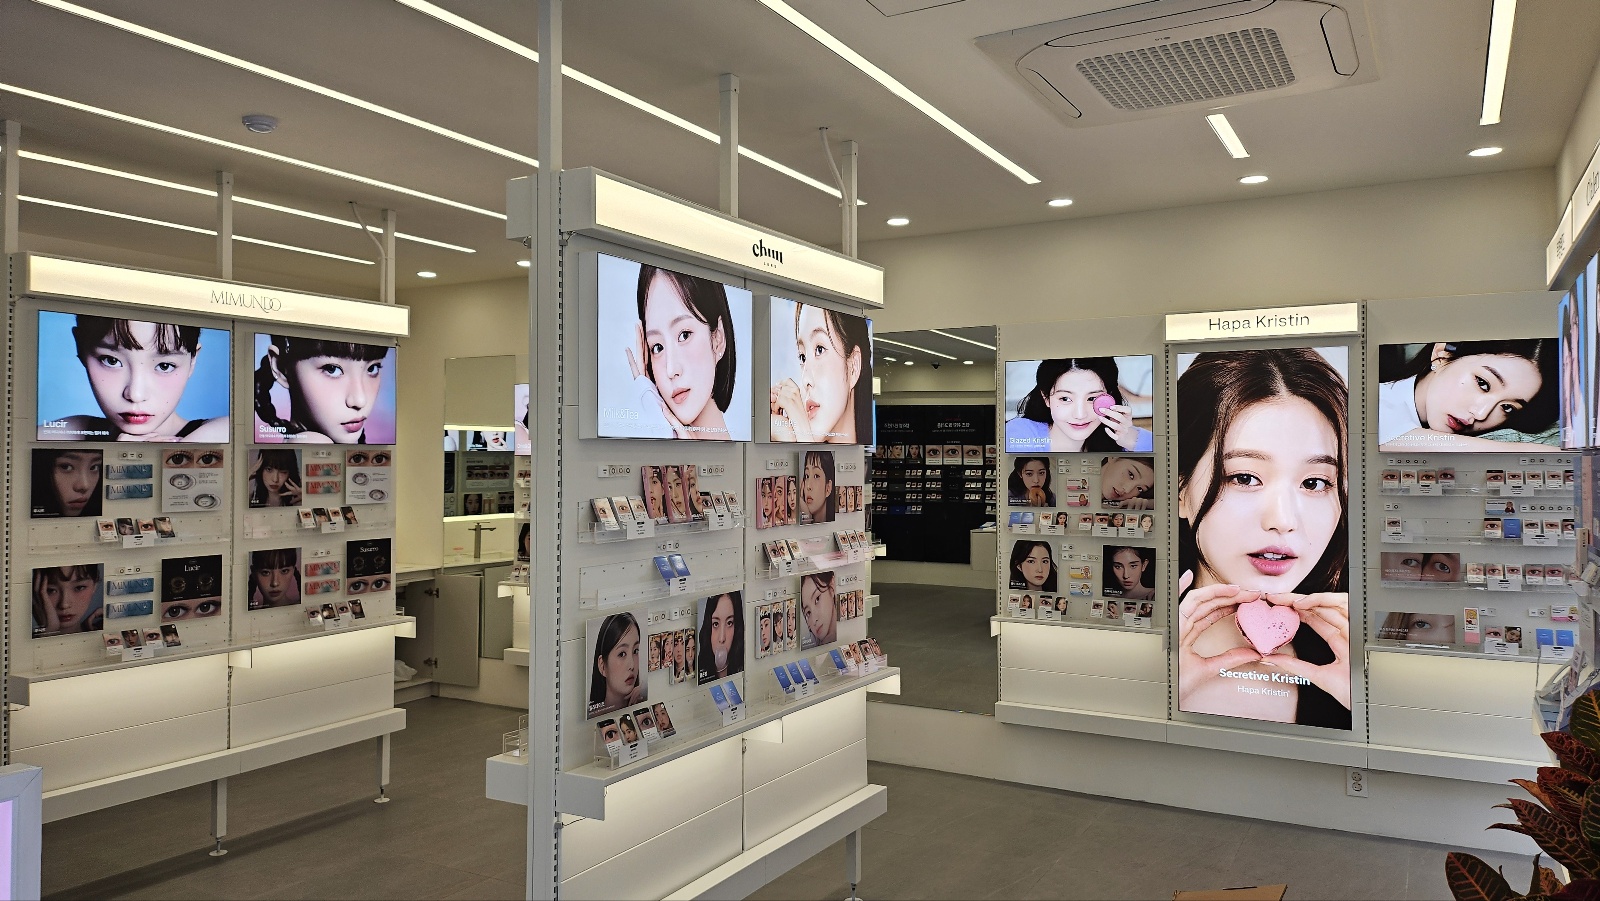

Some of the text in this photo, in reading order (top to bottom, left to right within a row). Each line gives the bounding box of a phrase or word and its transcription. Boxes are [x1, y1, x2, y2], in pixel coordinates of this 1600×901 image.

[752, 238, 784, 265] chuu
[210, 290, 282, 314] MIMUNDO
[1208, 313, 1310, 333] Hapa Kristin
[603, 407, 639, 420] Milk&Tea
[43, 419, 68, 428] Lucir
[259, 425, 287, 433] Susurro
[1427, 433, 1455, 441] Kristin
[184, 564, 201, 572] Lucir
[1219, 668, 1311, 686] Secretive Kristin
[1237, 685, 1289, 698] Hapa Kristin
